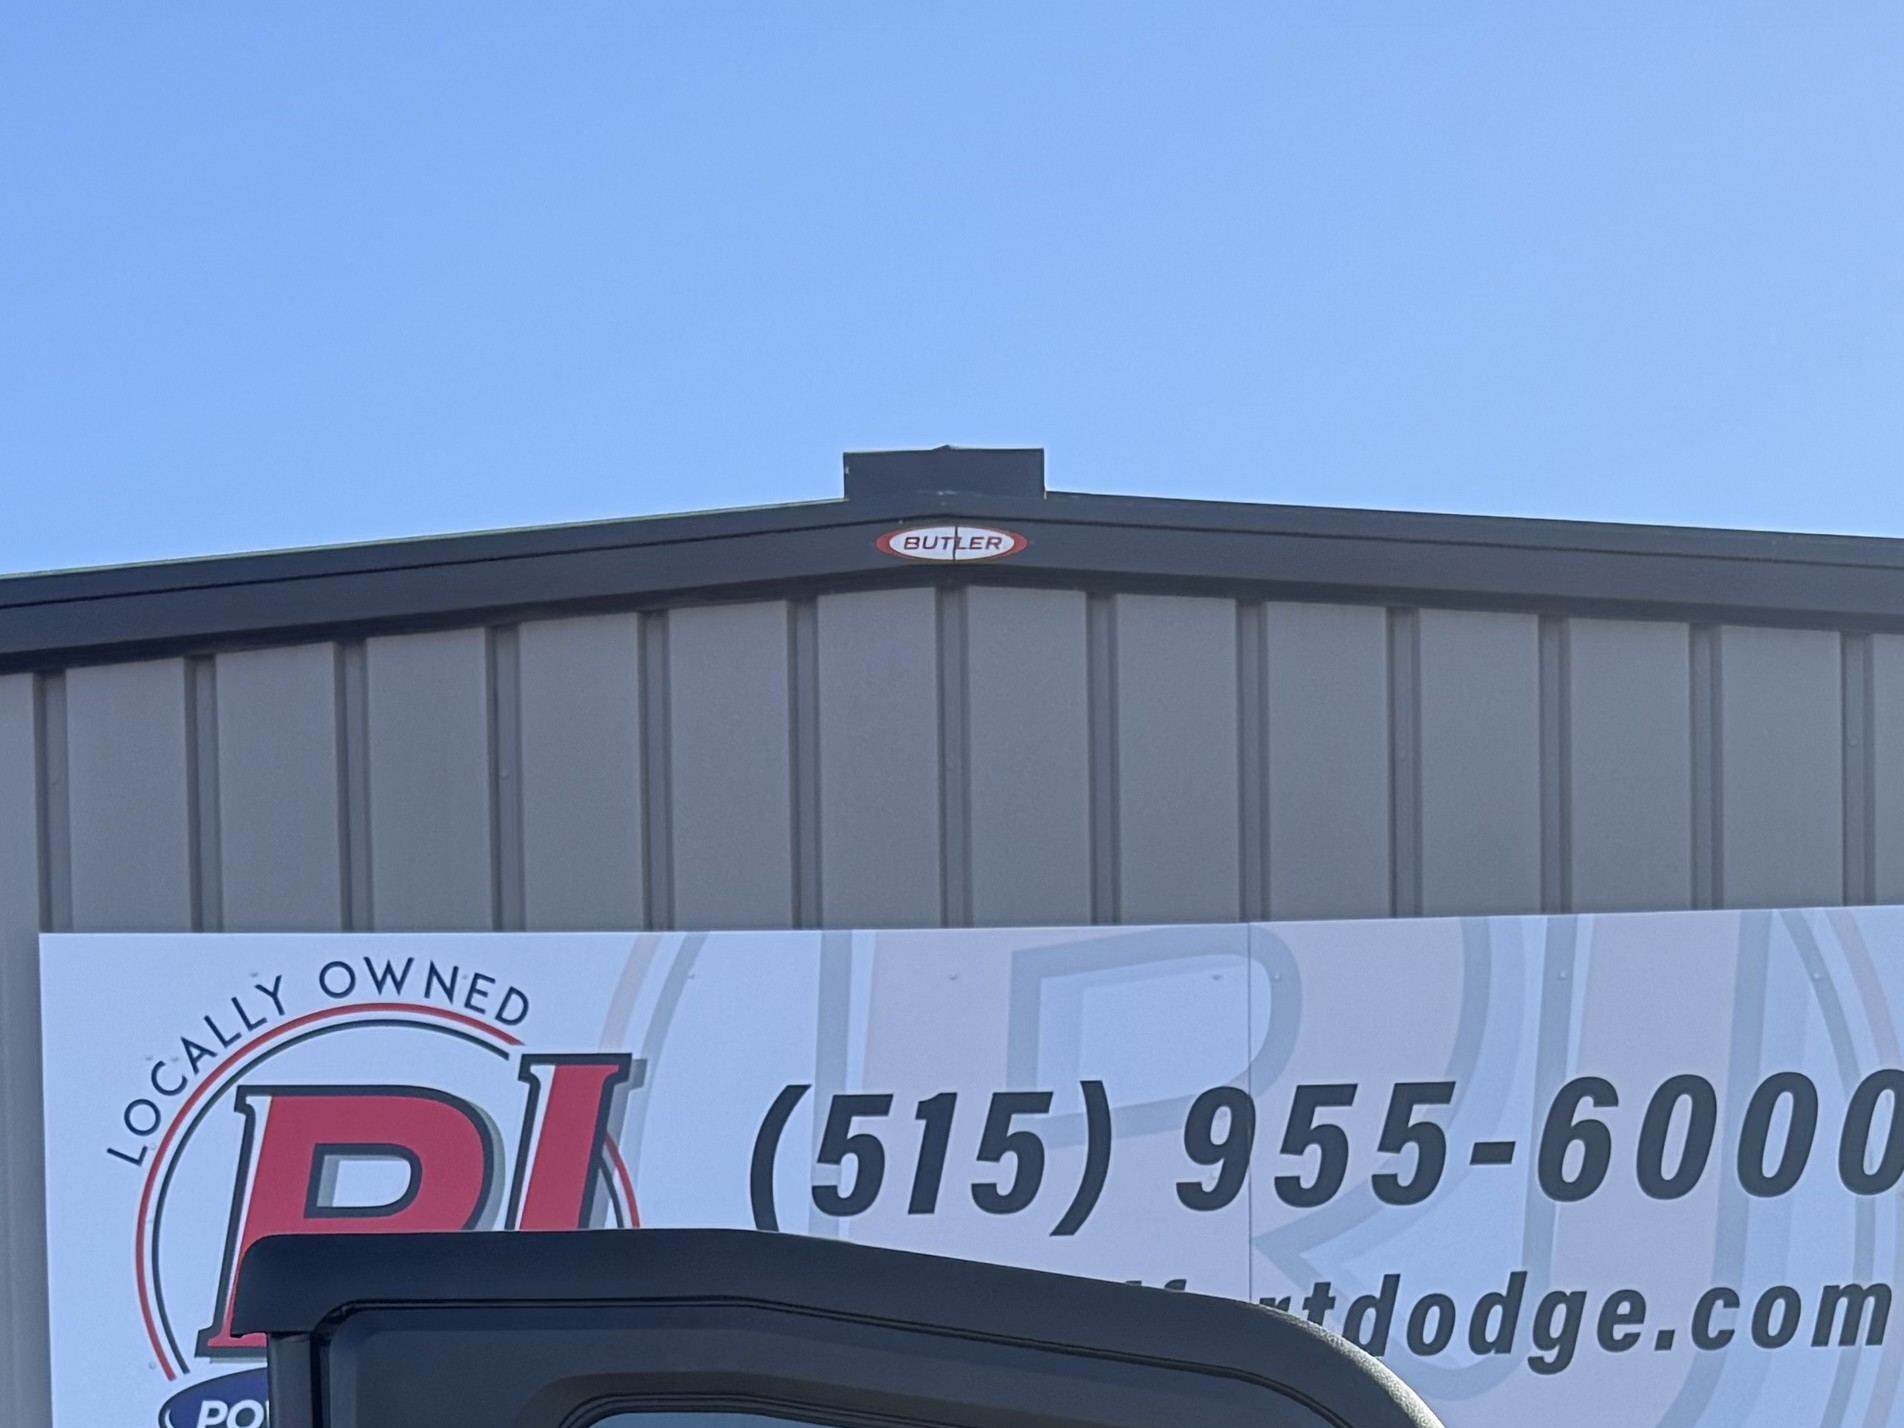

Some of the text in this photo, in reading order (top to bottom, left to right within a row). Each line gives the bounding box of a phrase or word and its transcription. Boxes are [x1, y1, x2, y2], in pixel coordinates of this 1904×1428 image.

[903, 536, 1003, 550] BUTLER
[106, 956, 529, 1168] LOCALLY OWNED
[749, 1081, 1113, 1236] (515)
